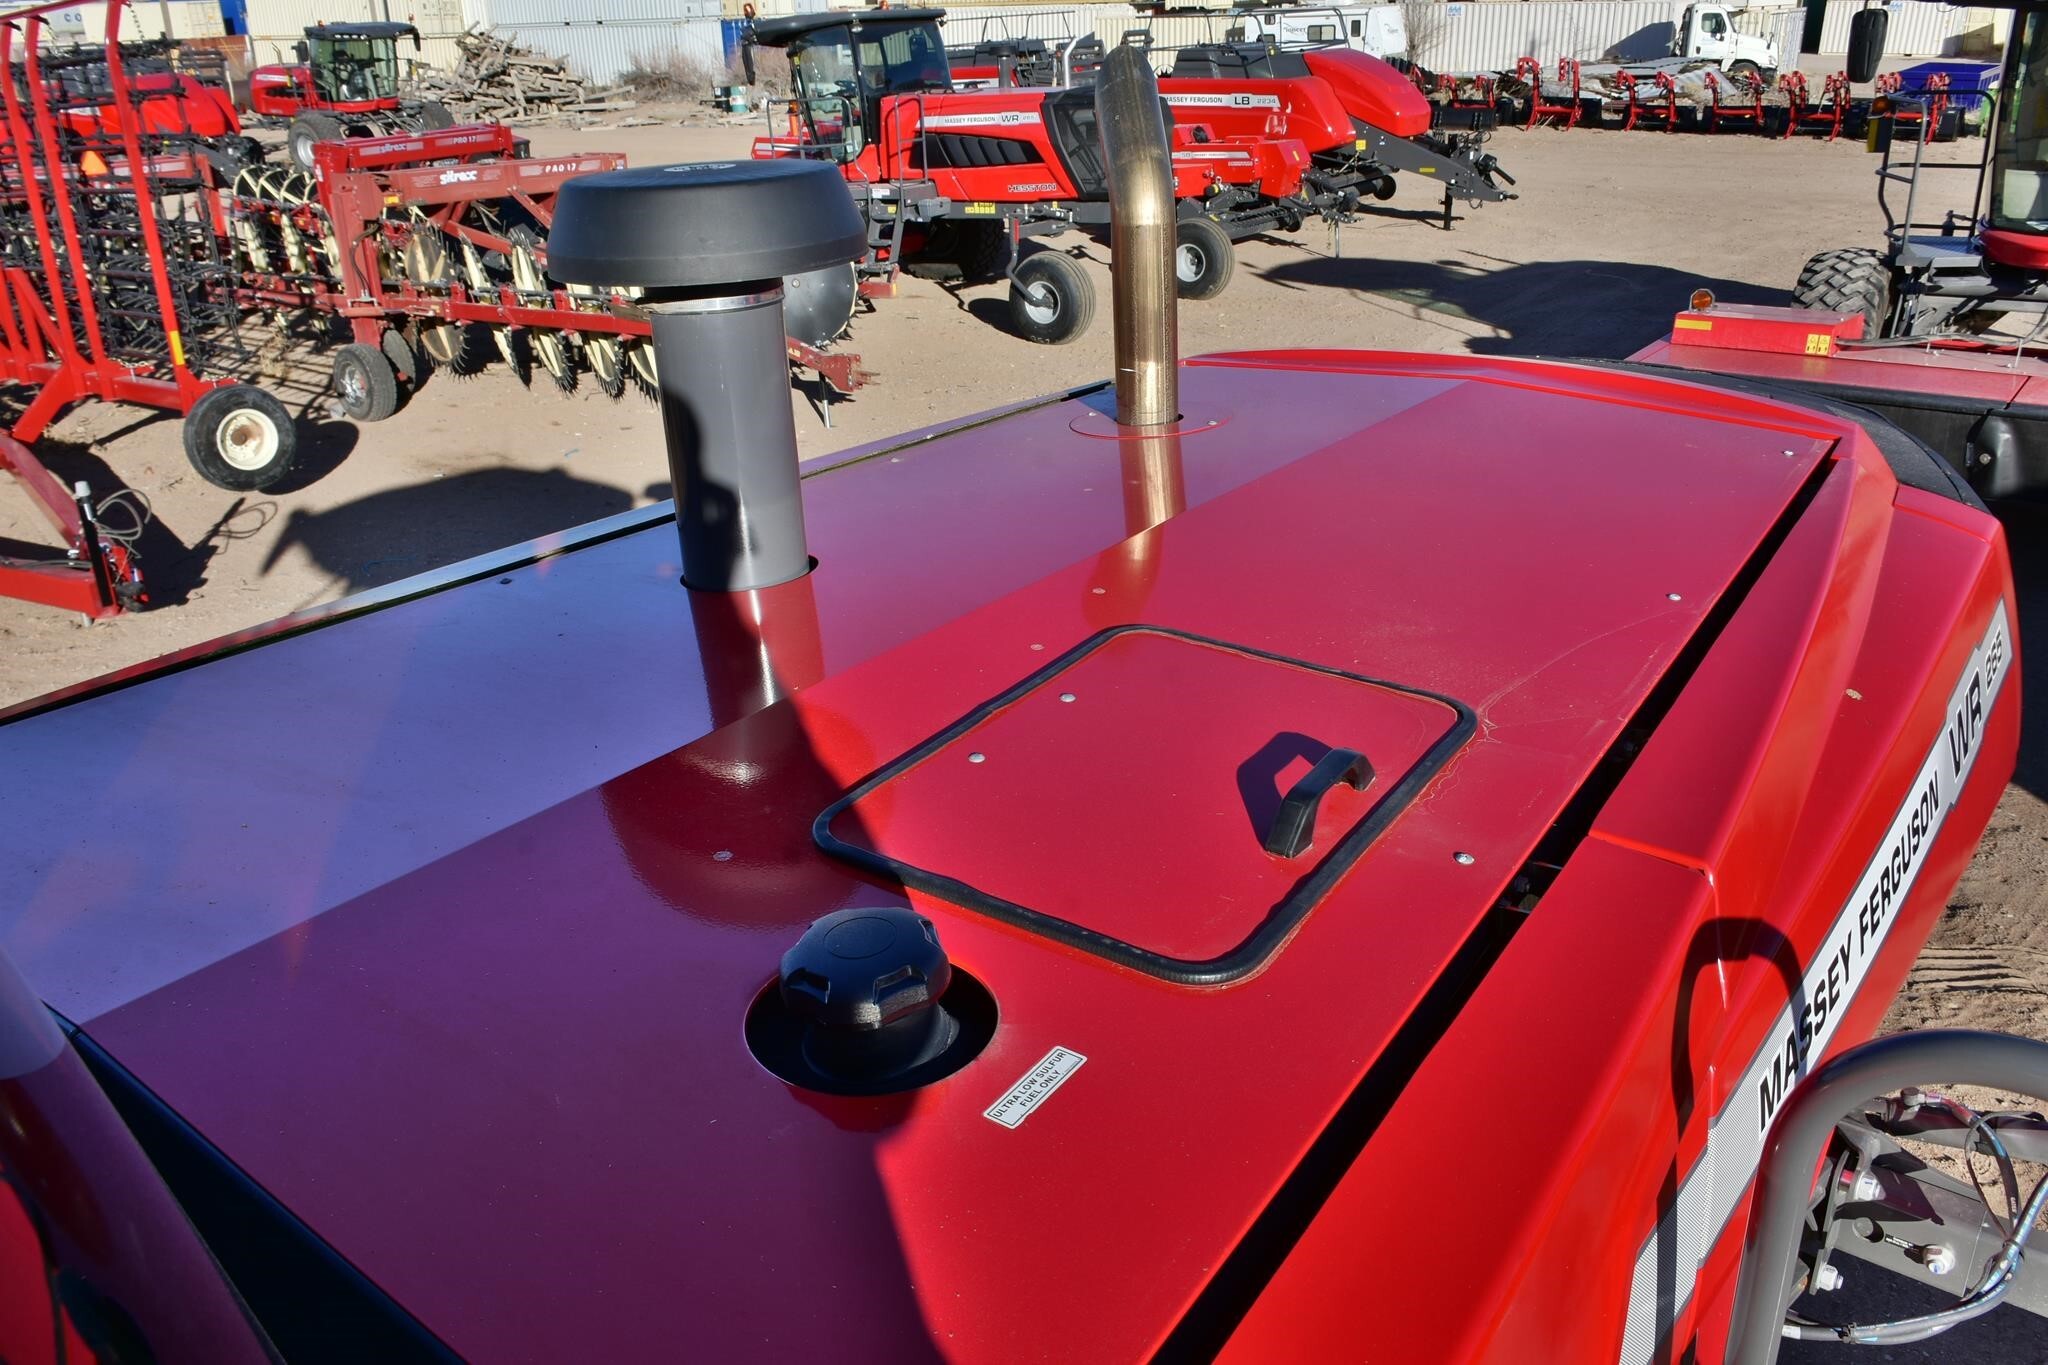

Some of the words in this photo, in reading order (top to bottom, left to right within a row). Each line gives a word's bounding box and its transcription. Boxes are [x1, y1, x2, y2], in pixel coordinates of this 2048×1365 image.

[1234, 96, 1250, 105] LB
[1001, 114, 1019, 122] WR
[453, 137, 466, 145] PRO
[567, 162, 576, 171] 17
[440, 170, 477, 185] sitrex
[1008, 183, 1057, 192] HESSTON
[1759, 932, 1852, 1134] MASSEY
[1858, 769, 1939, 957] FERGUSON
[1948, 669, 1983, 780] WR
[1985, 626, 2003, 692] 265
[993, 1095, 1021, 1118] ULTRA
[1018, 1078, 1038, 1095] LOW
[1036, 1052, 1066, 1079] SULFUR
[1020, 1090, 1042, 1107] FUEL
[1040, 1070, 1060, 1088] ONLY
